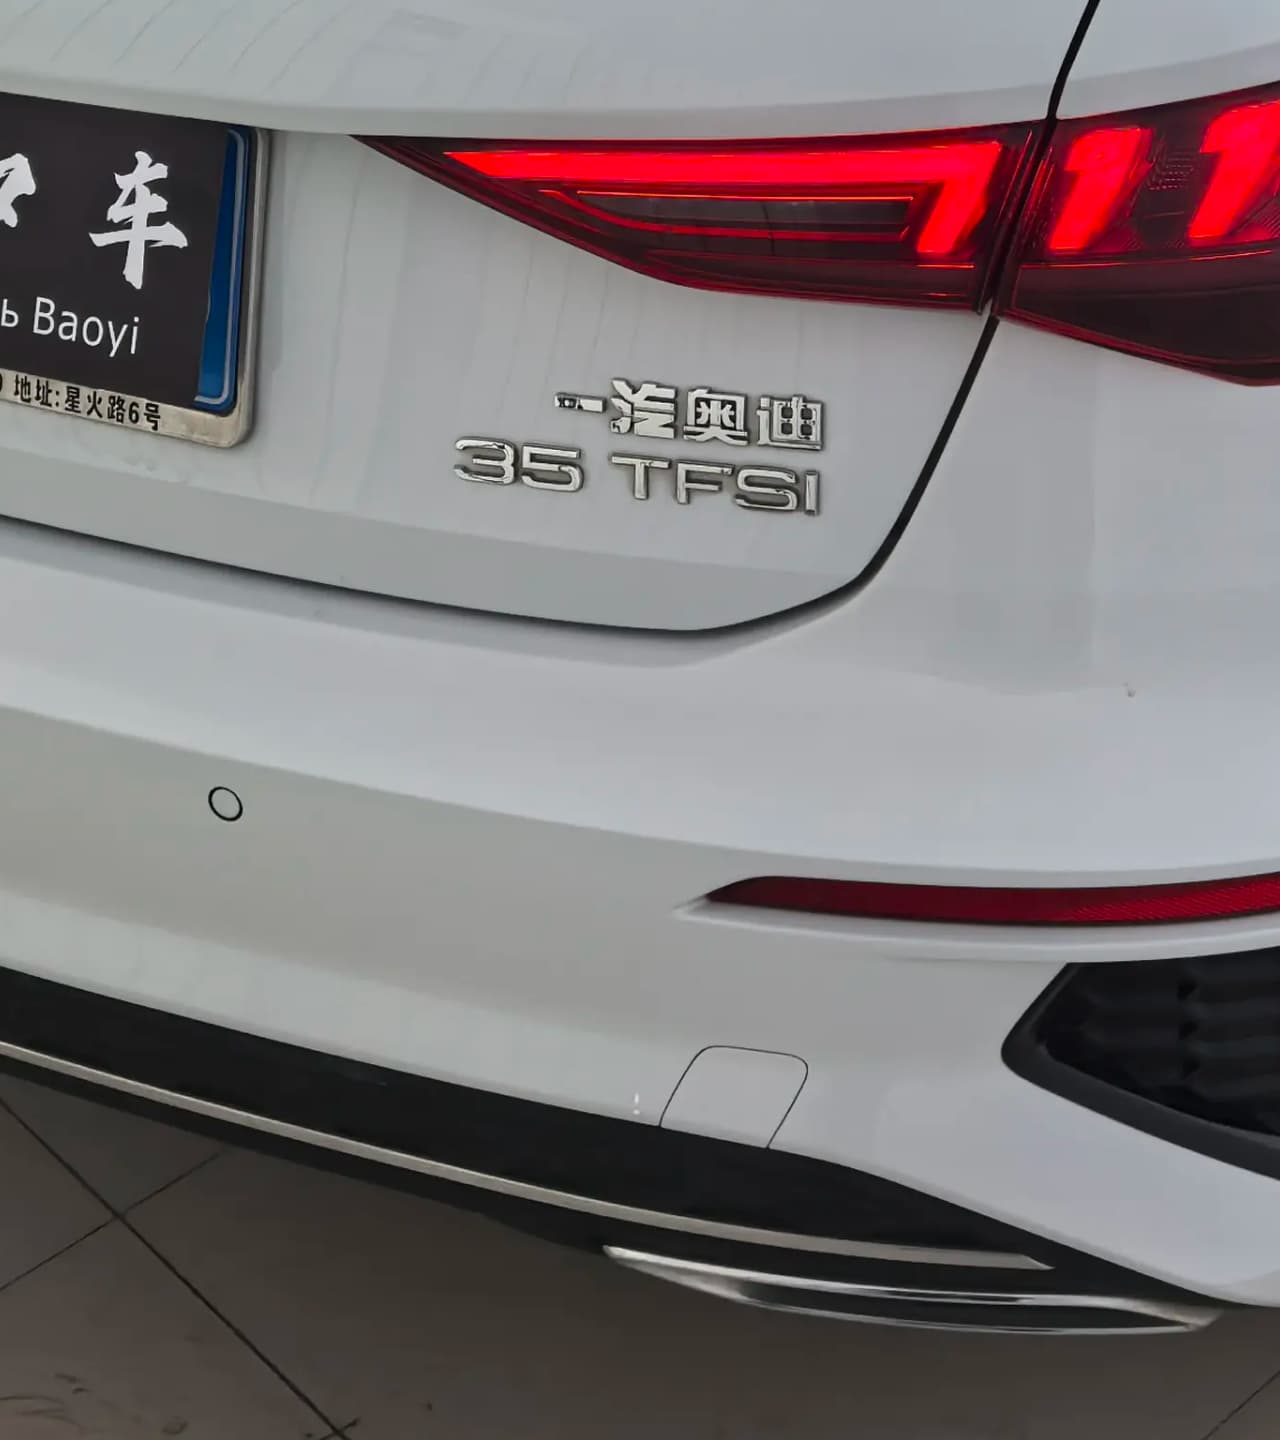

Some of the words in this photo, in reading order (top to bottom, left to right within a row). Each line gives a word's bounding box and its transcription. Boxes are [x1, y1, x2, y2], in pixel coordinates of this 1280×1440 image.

[31, 297, 140, 357] Baoyi
[554, 377, 824, 452] 一汽奥迪
[452, 436, 585, 493] 35
[610, 452, 822, 517] TFSI
